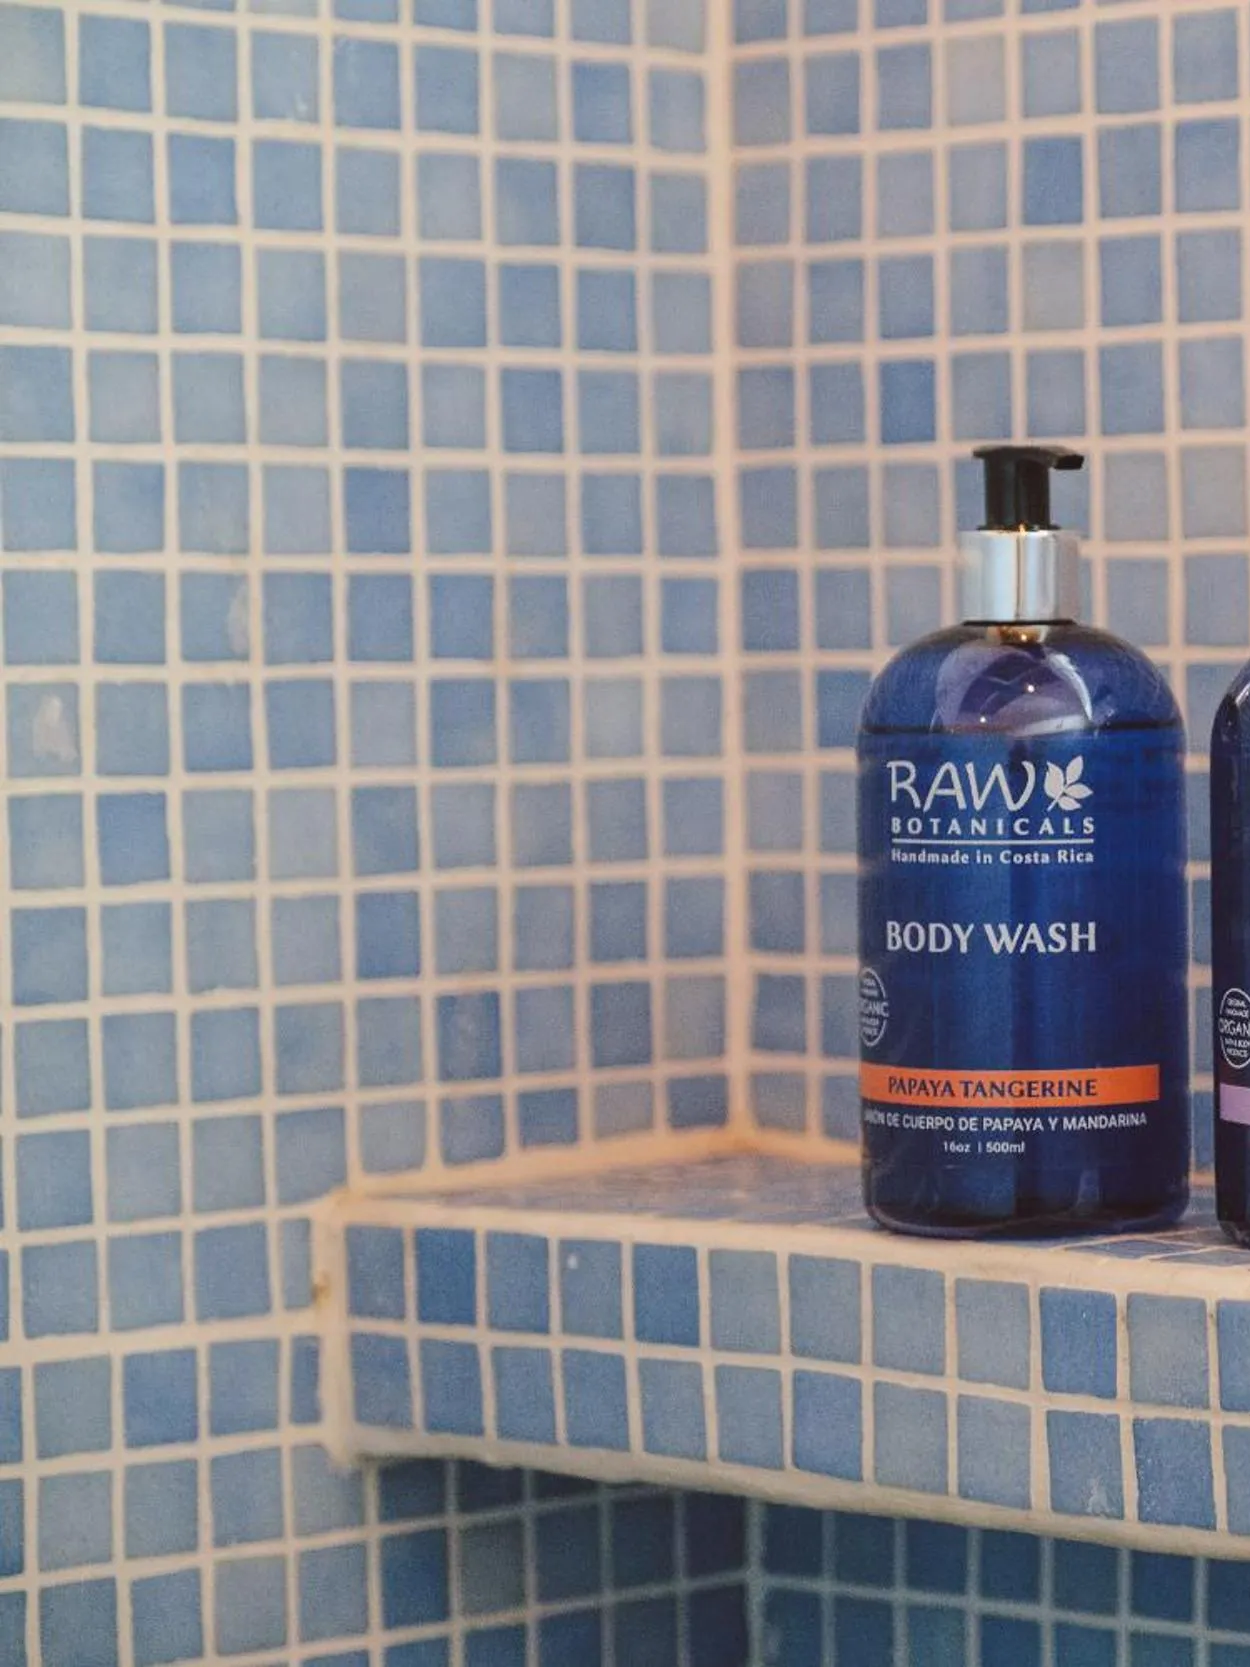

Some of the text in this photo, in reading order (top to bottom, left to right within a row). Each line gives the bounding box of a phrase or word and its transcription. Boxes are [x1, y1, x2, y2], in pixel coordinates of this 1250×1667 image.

[886, 760, 1036, 812] RAW
[891, 817, 1095, 836] BOTANICALS
[891, 848, 1094, 865] Handmade in Costa Rica
[886, 921, 1096, 954] BODY WASH
[888, 1075, 1098, 1099] PAPAYA TANGERINE
[902, 1115, 954, 1132] CUERPO
[958, 1117, 978, 1132] DE
[982, 1117, 1044, 1132] PAPAYA
[1048, 1117, 1058, 1131] Y
[1062, 1111, 1147, 1131] MANDARINA
[943, 1141, 971, 1153] 16oz
[985, 1141, 1025, 1153] 500ml
